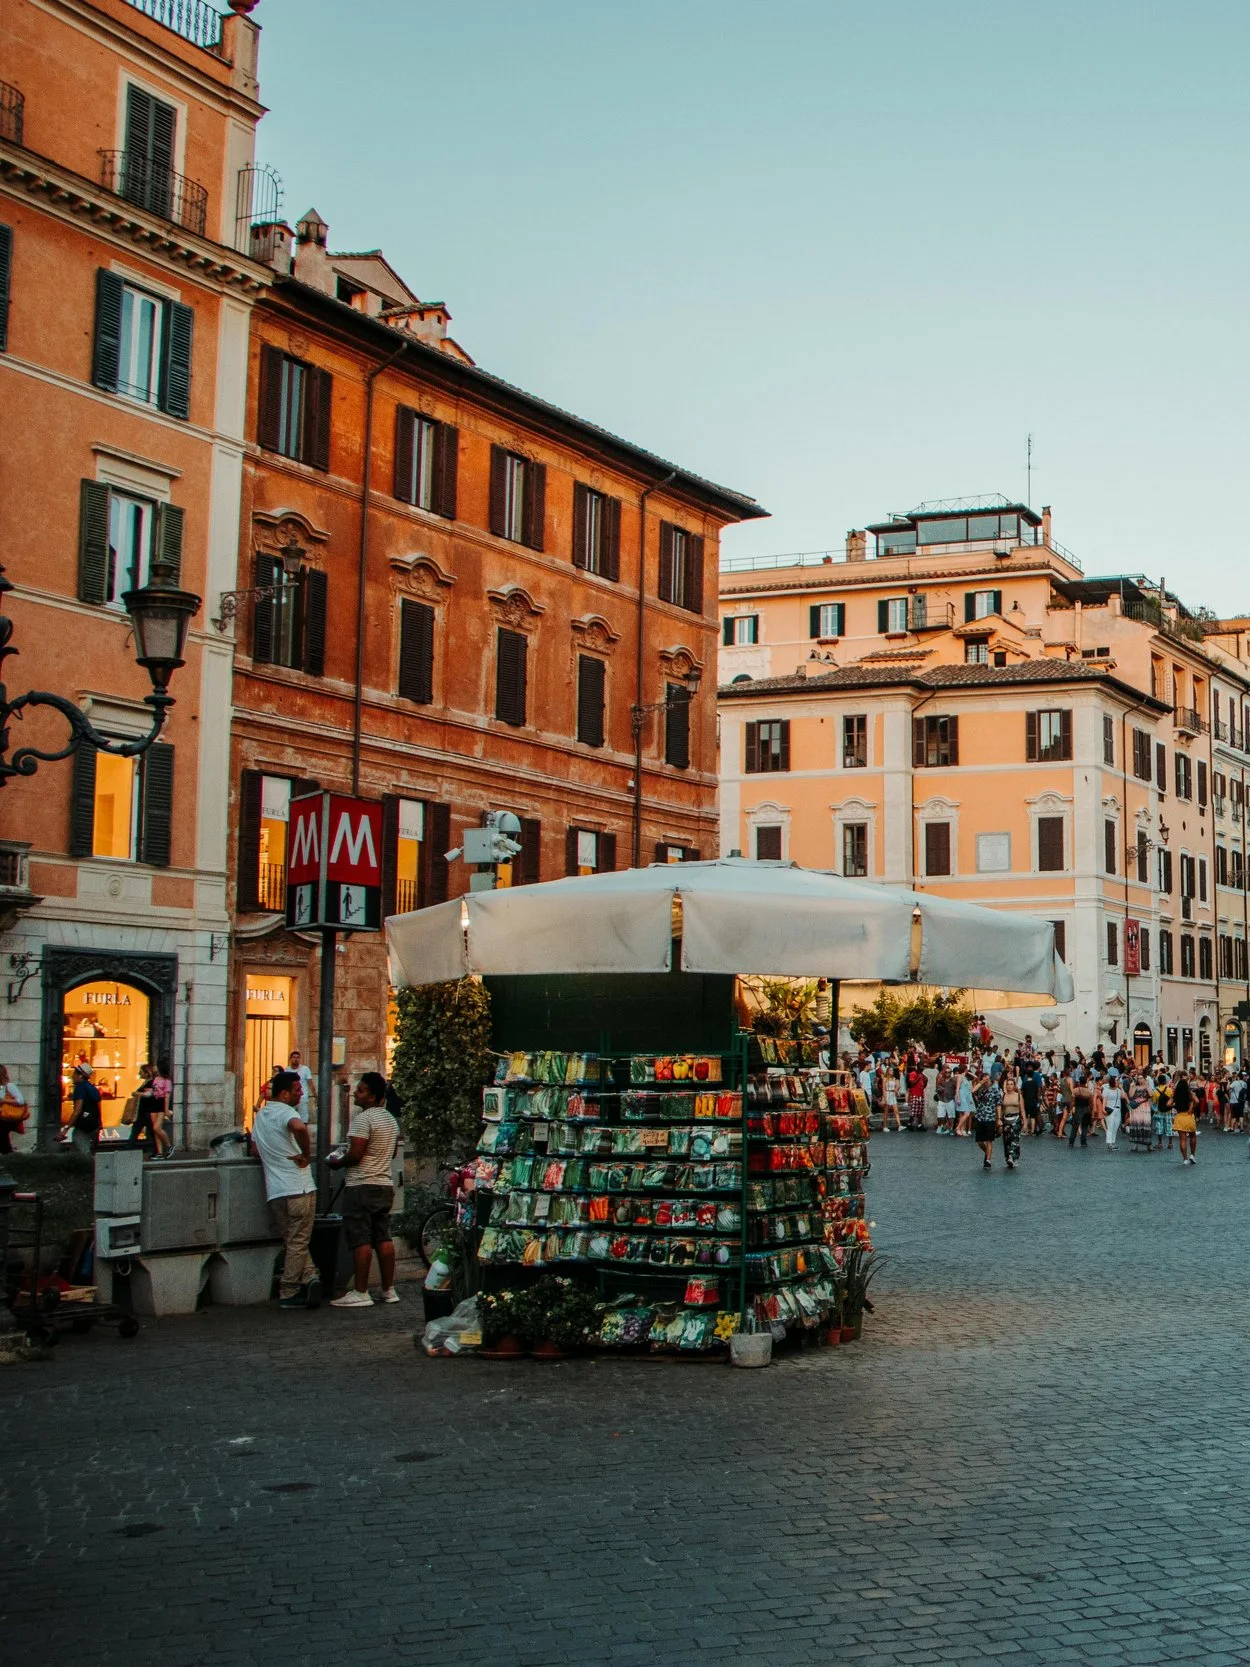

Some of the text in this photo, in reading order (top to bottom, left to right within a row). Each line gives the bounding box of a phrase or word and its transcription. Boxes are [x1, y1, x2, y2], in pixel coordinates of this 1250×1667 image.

[262, 806, 286, 817] FURLA
[291, 812, 320, 868] M
[330, 812, 378, 868] M
[85, 992, 132, 1005] FURLA
[246, 988, 285, 1001] FURLA
